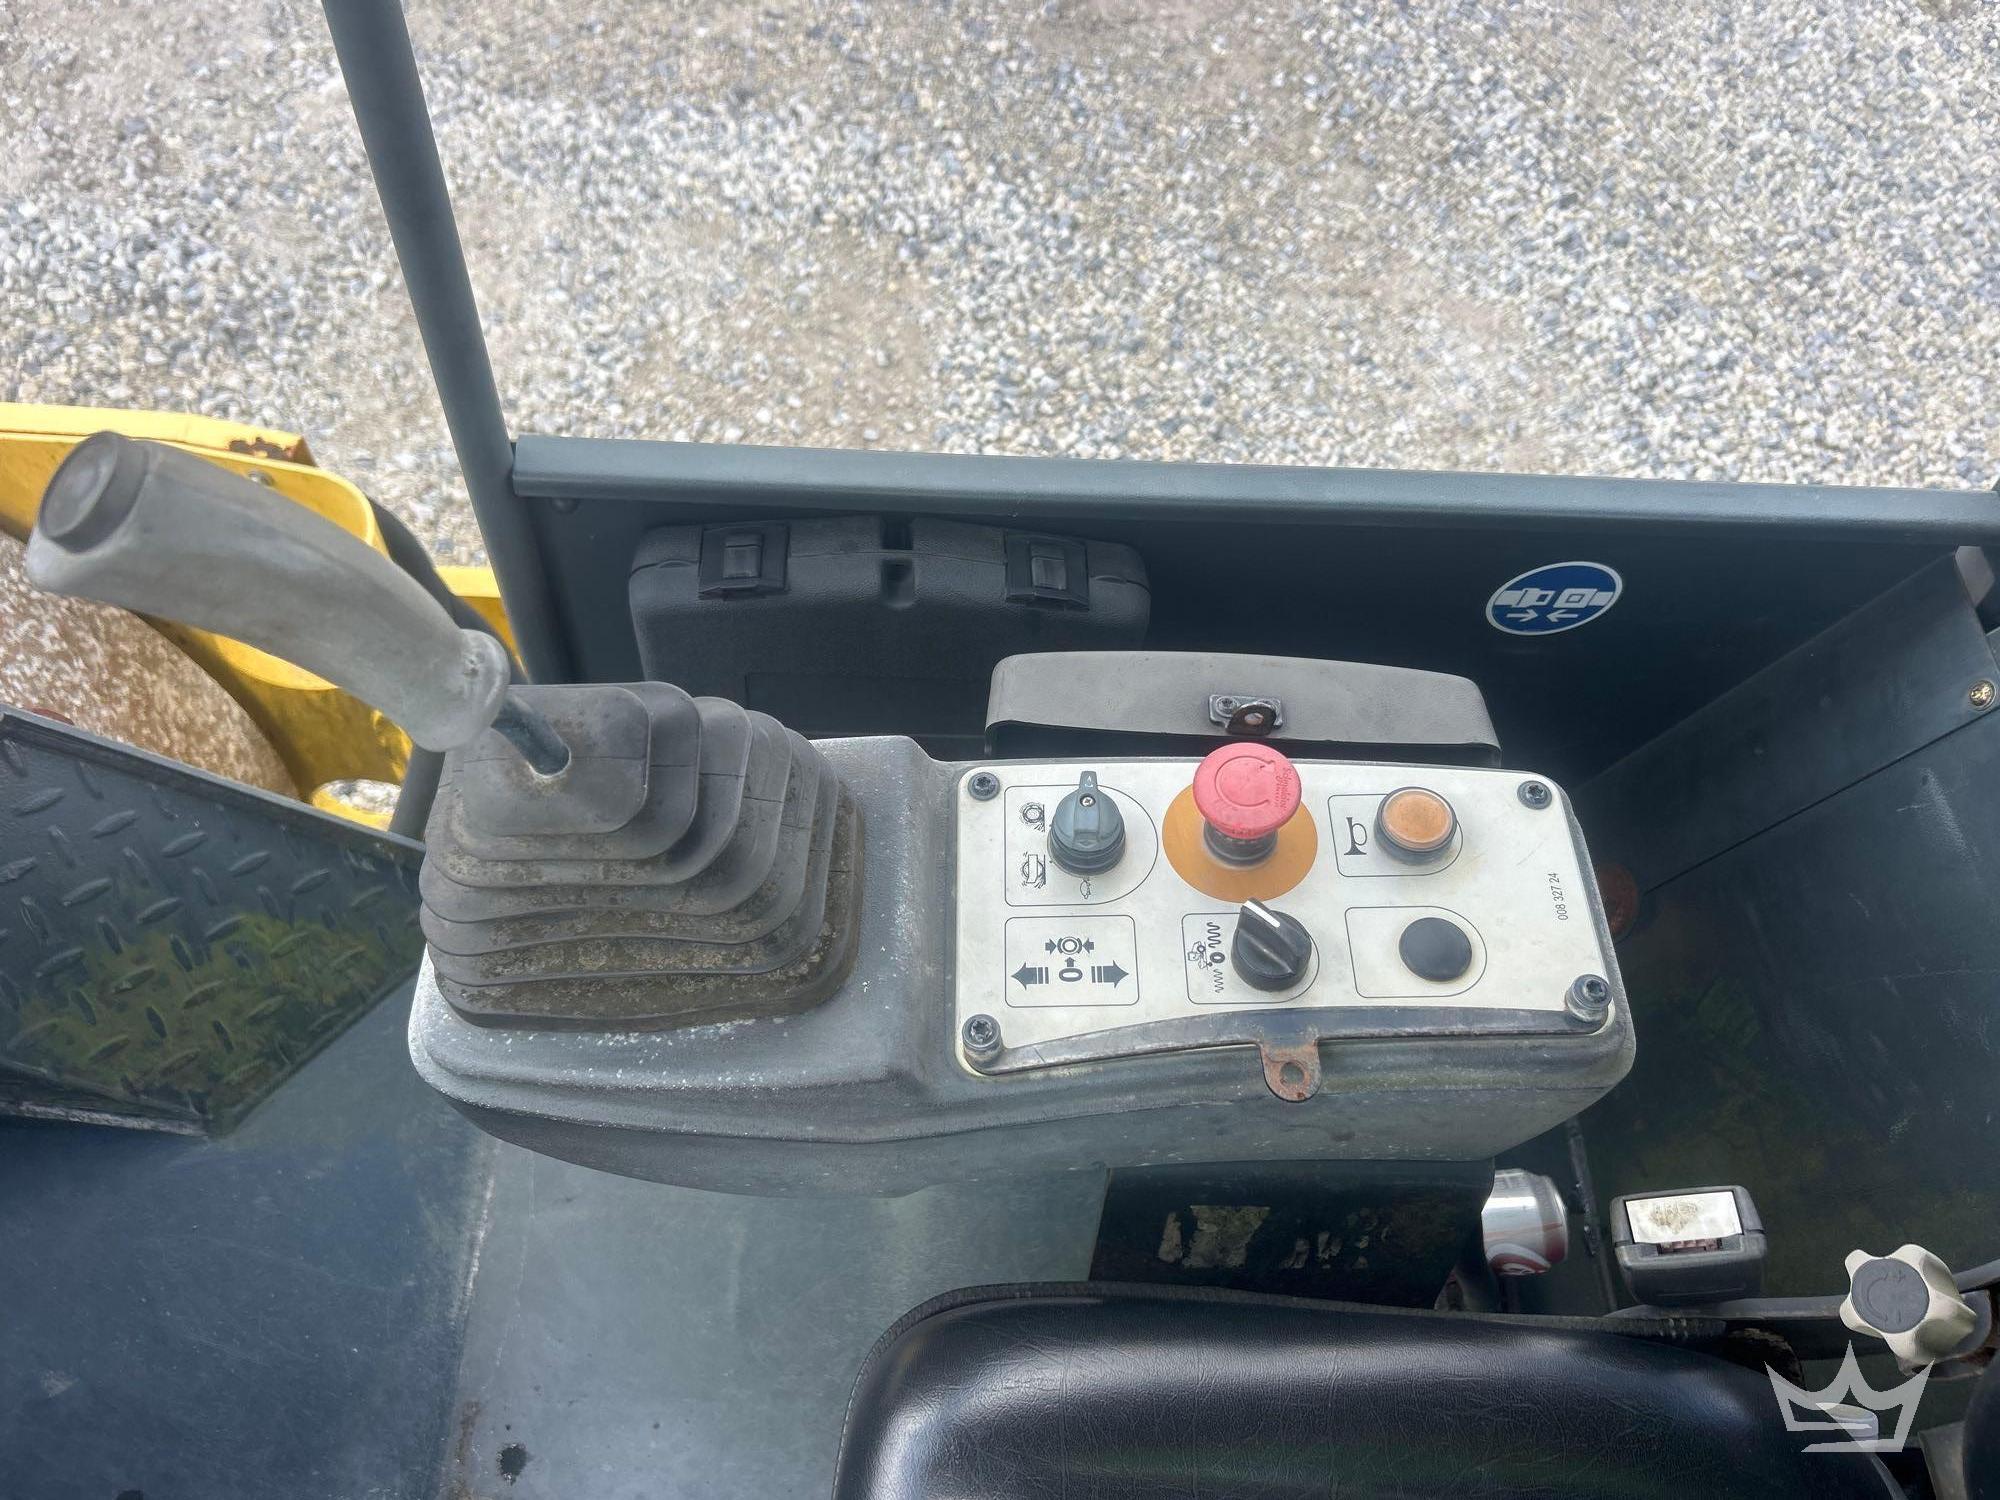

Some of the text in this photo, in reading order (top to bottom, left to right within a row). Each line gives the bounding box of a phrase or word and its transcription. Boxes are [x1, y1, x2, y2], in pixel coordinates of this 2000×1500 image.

[1548, 872, 1568, 920] 008 327 24
